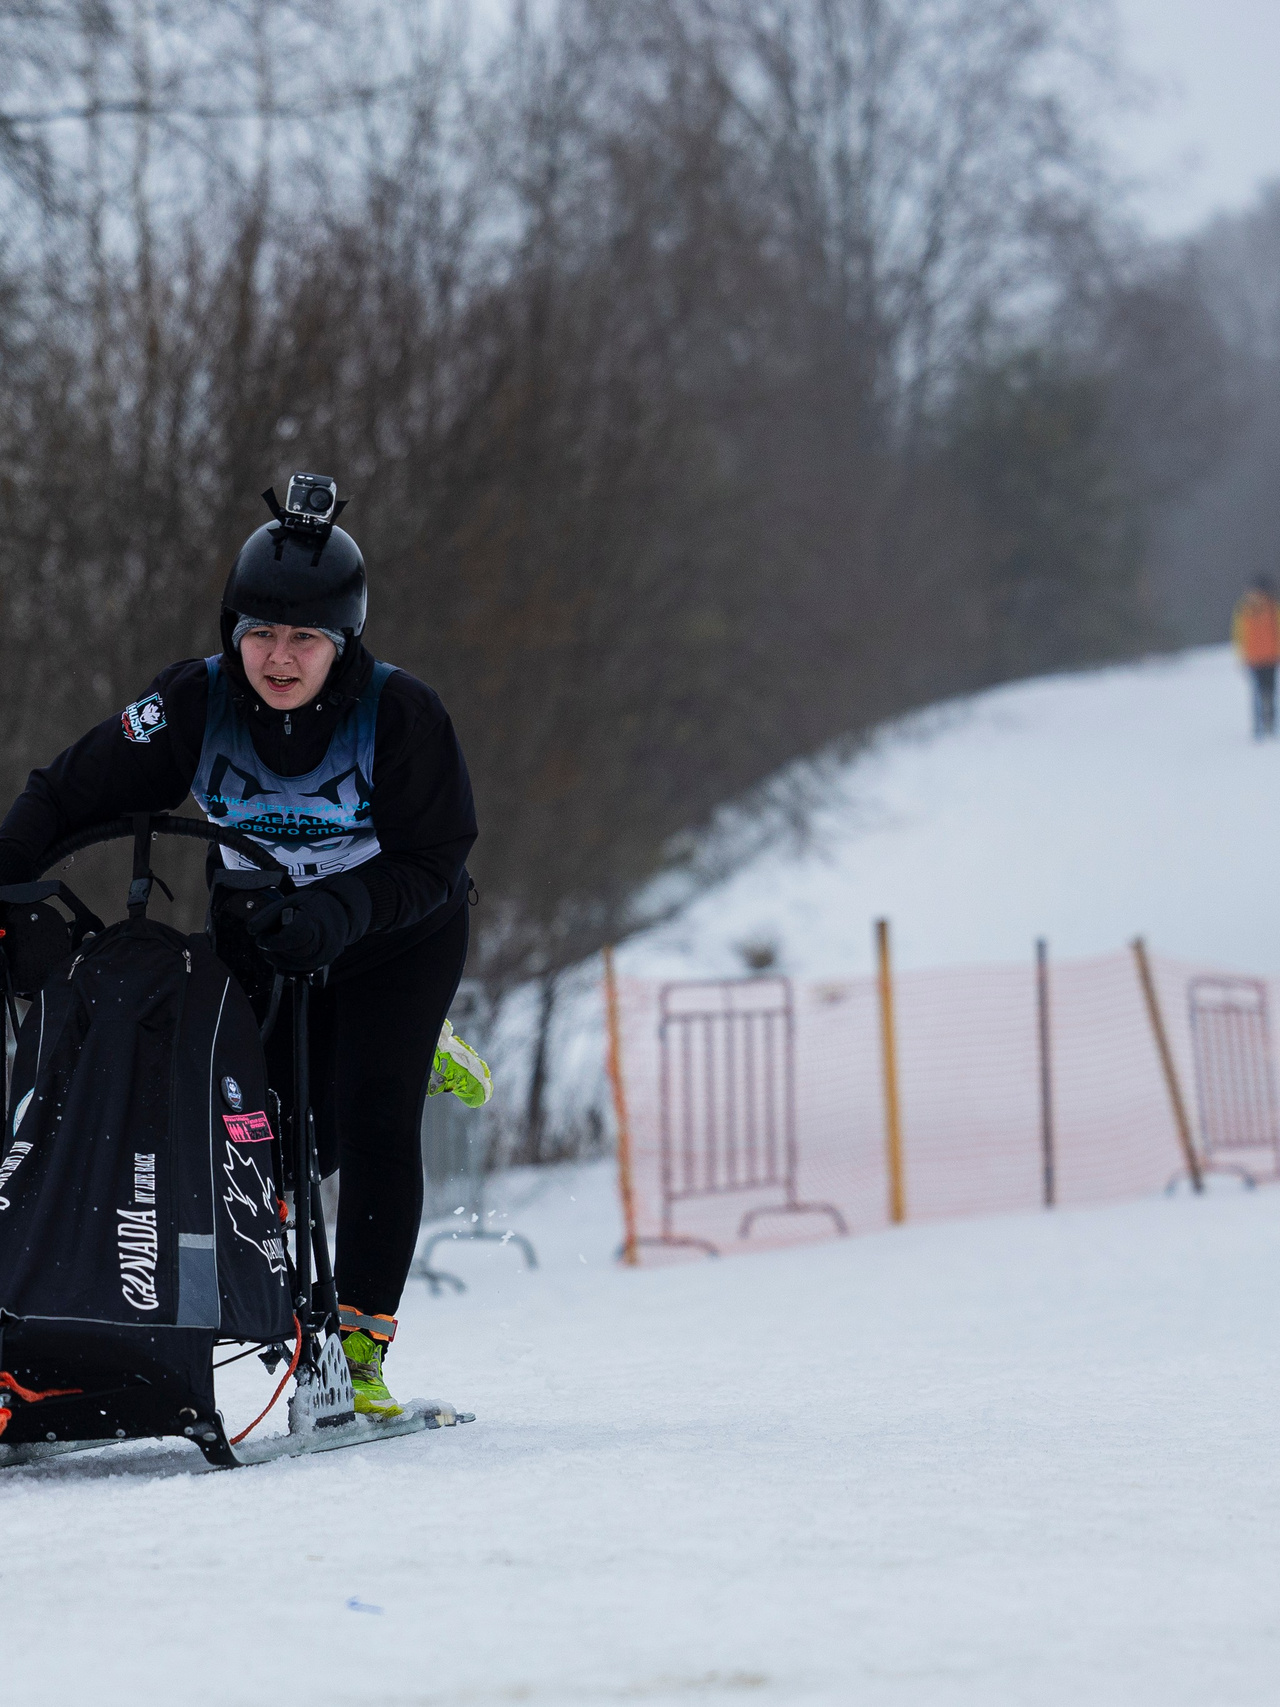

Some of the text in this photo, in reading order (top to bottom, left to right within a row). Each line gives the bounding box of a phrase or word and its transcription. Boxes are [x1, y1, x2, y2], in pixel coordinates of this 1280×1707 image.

[127, 704, 148, 741] HUSKY
[201, 792, 371, 815] САНКТ-ПЕТЕРБУРГСКА
[216, 817, 300, 836] ДОВОГО
[116, 1152, 160, 1311] CANADA MY LIFE RACE
